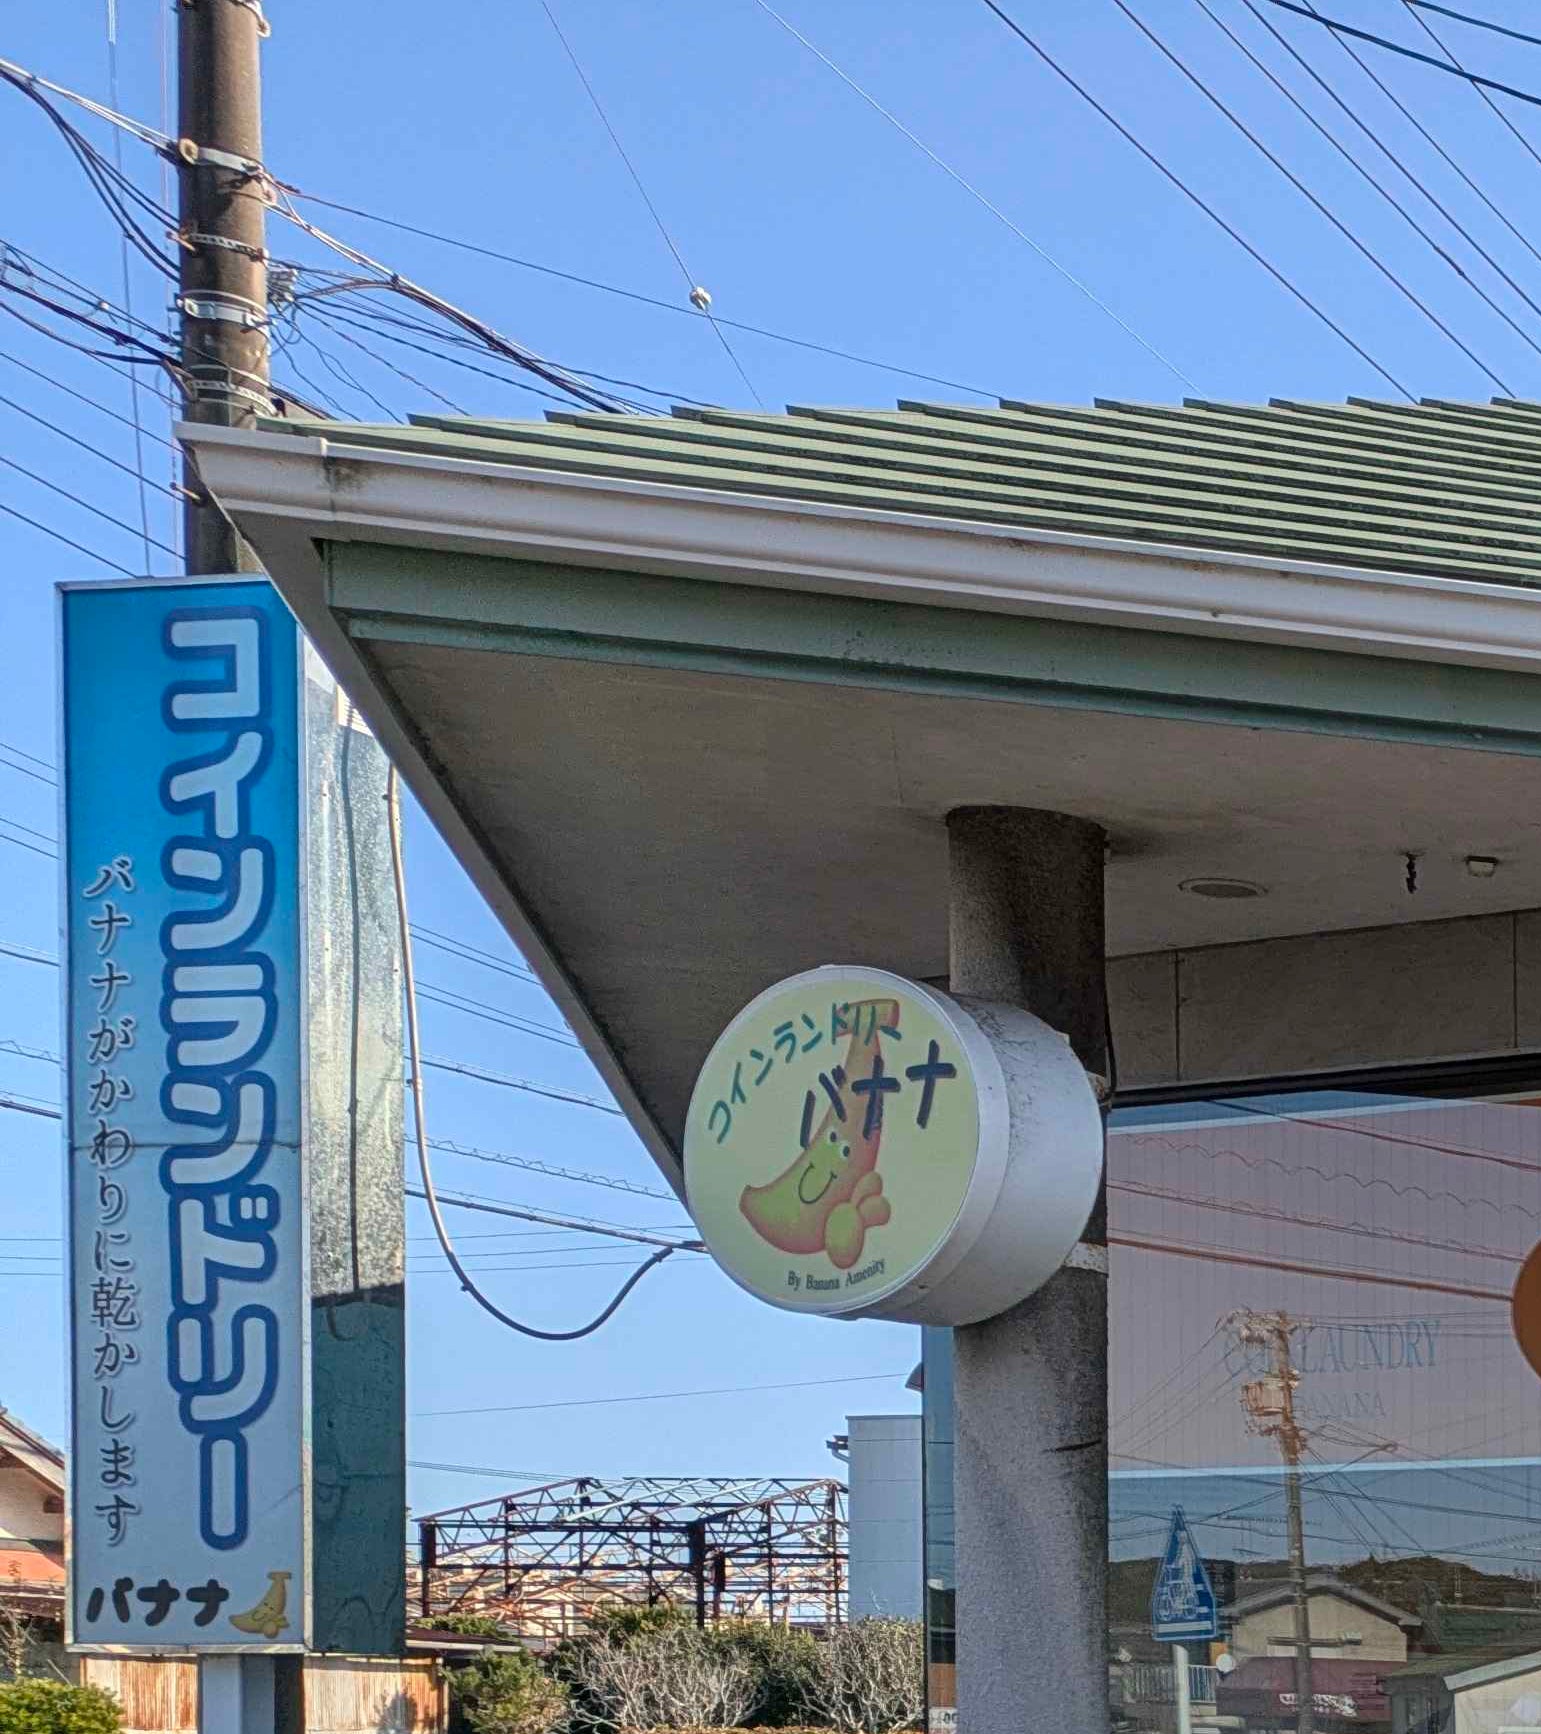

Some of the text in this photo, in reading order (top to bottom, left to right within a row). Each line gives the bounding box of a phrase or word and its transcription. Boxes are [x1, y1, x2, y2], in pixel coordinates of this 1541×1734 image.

[162, 608, 279, 1550] コインランドリー
[708, 1002, 902, 1144] コインランドリー
[800, 1039, 957, 1150] バナナ
[84, 855, 140, 1548] バナナがかわりに乾かします
[86, 1576, 230, 1627] バナナ
